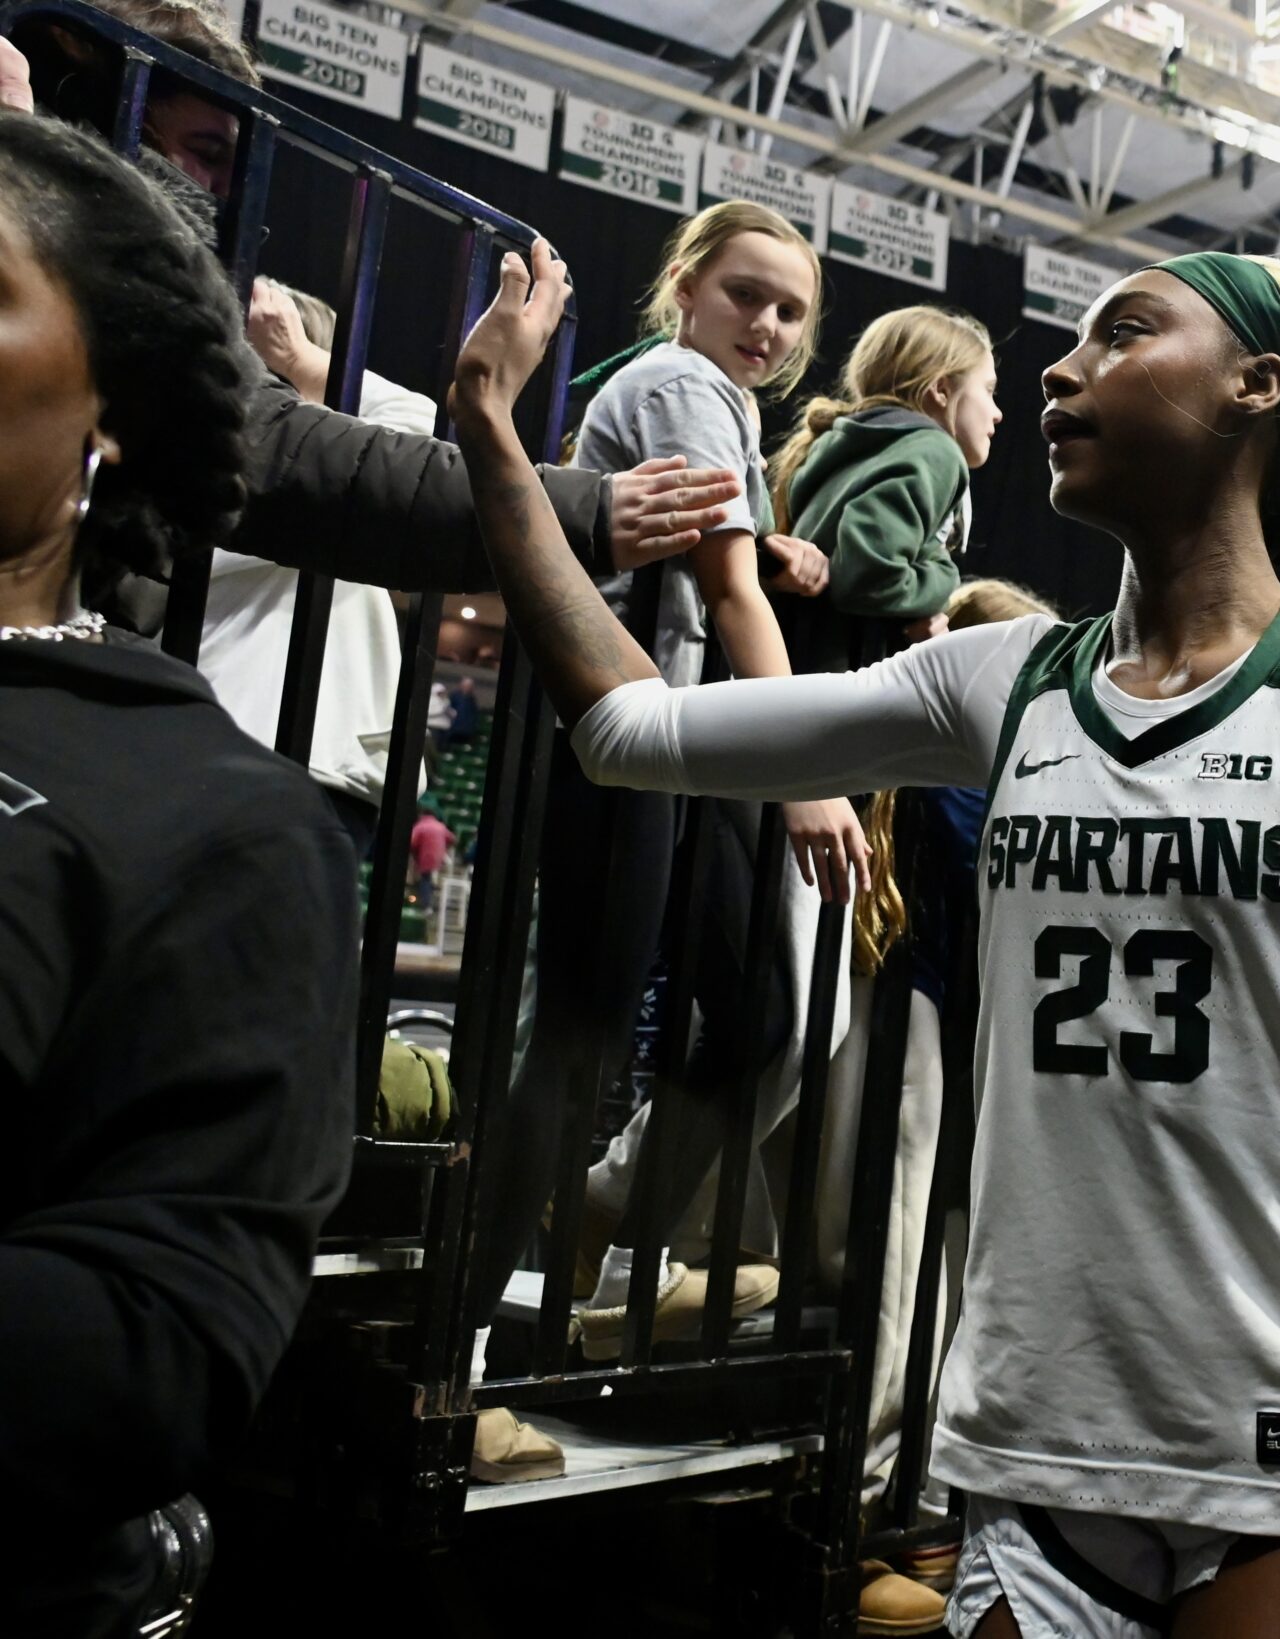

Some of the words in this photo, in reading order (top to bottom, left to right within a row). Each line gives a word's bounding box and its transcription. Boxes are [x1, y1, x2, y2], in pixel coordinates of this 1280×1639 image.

[265, 17, 400, 77] CHAMPIONS
[294, 5, 329, 31] BIG
[337, 21, 378, 48] TEN
[425, 75, 547, 130] CHAMPIONS
[450, 61, 483, 87] BIG
[491, 76, 527, 101] TEN
[581, 139, 686, 179] CHAMPIONS
[1033, 925, 1213, 1084] 23
